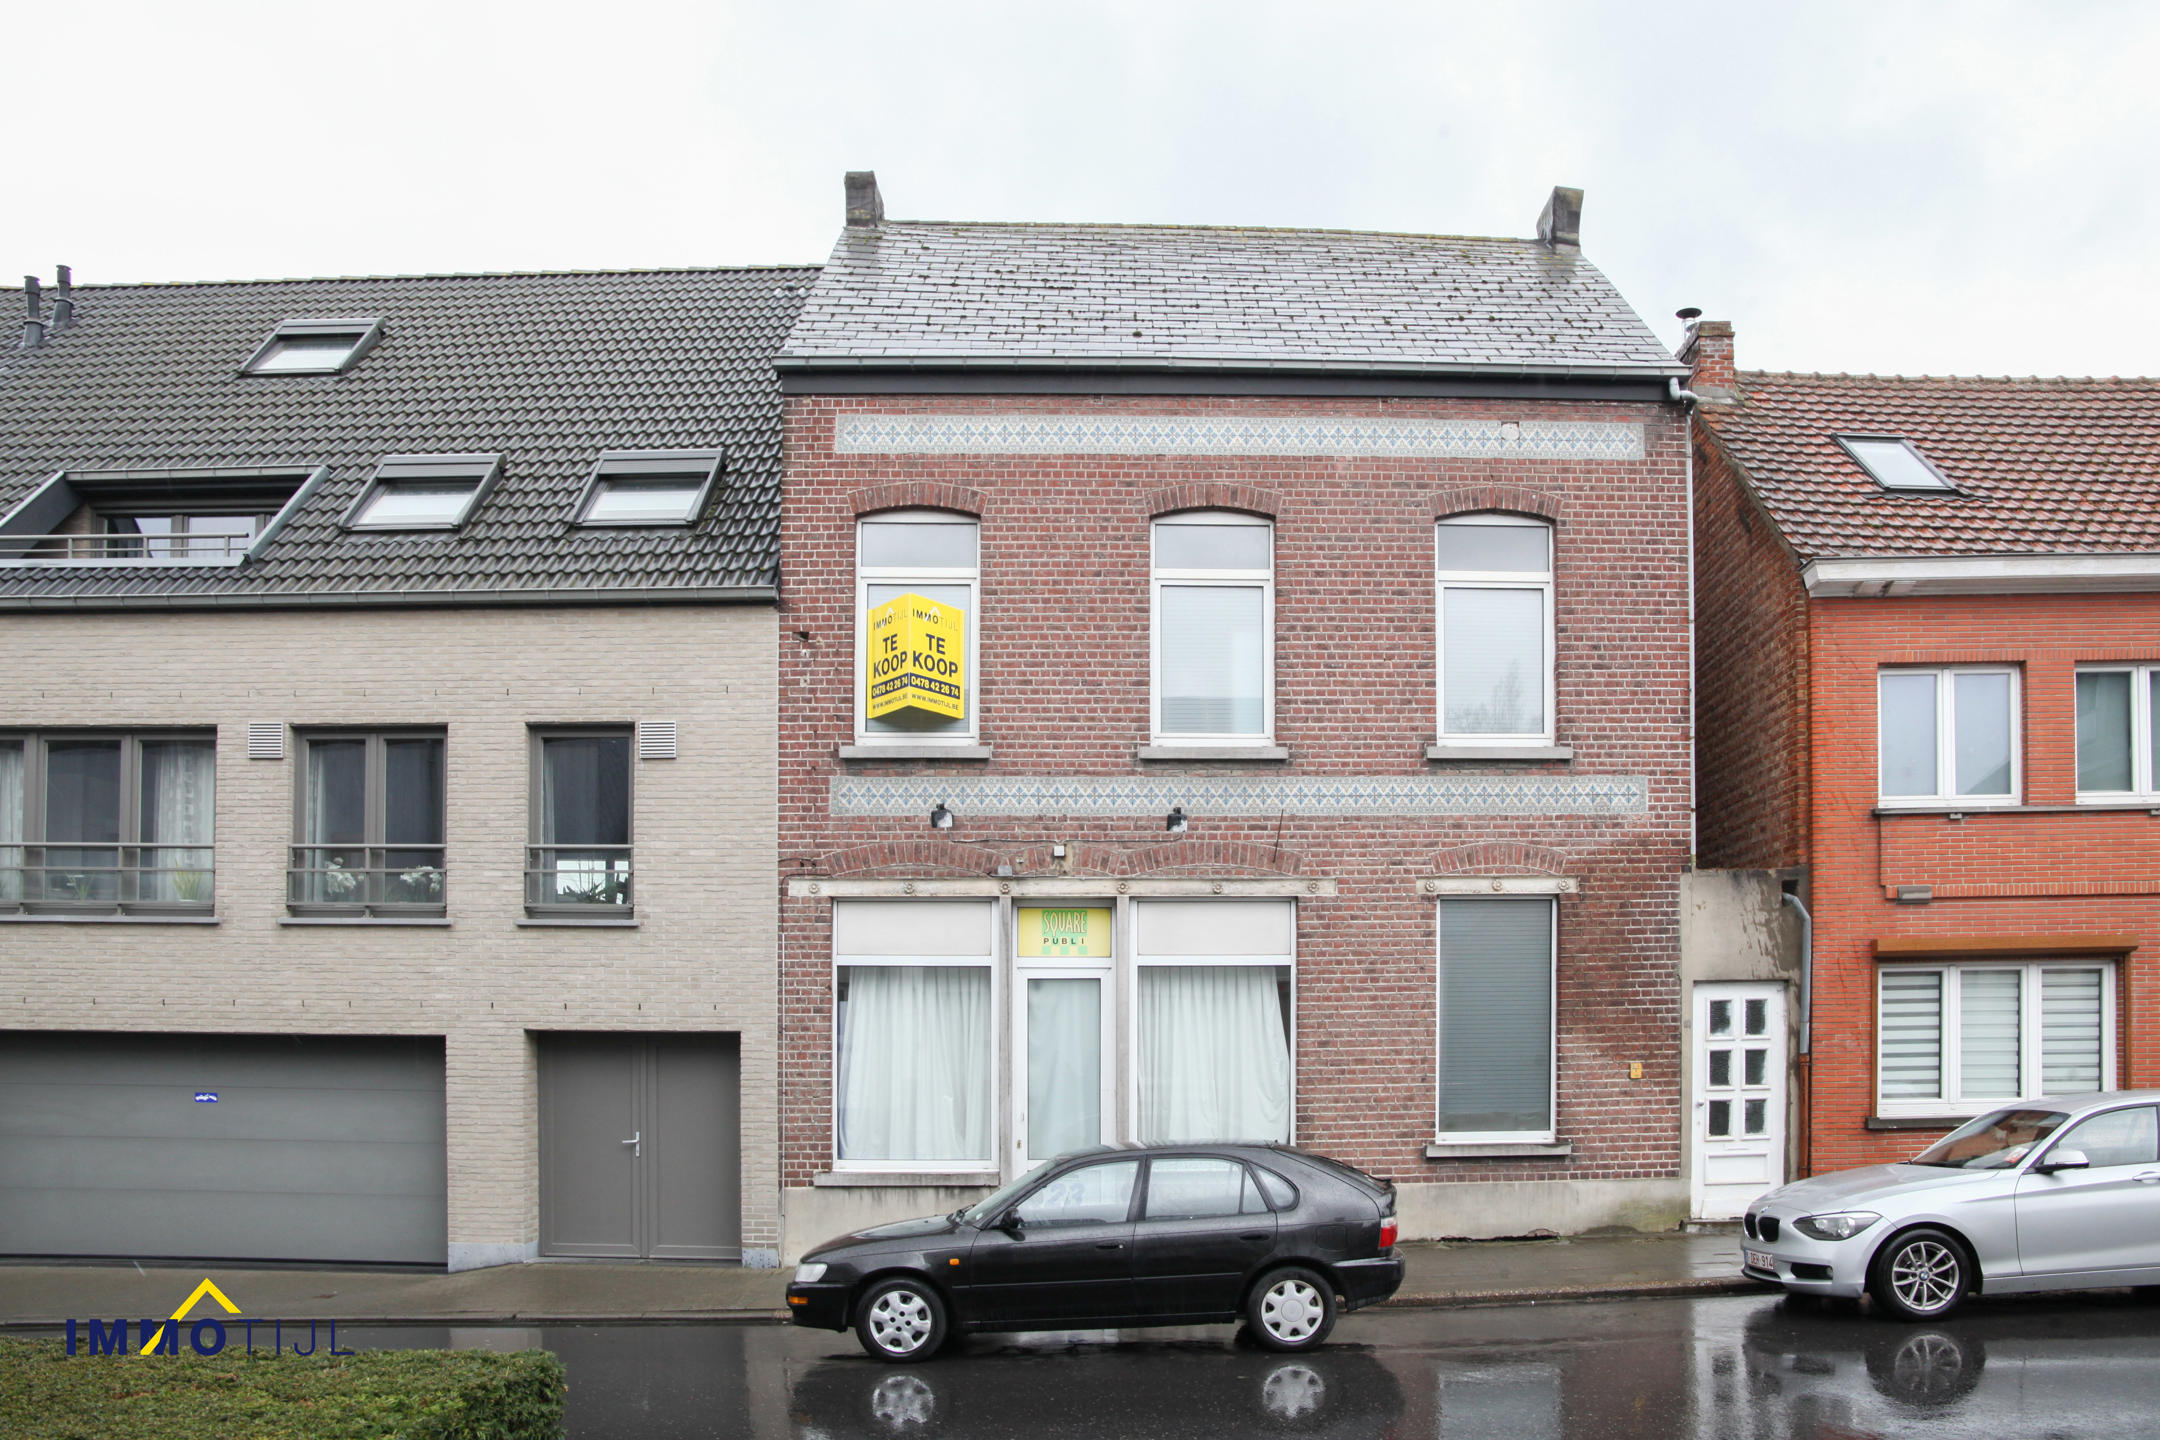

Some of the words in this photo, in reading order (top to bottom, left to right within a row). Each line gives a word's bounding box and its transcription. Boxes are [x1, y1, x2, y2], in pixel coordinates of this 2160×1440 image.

[883, 633, 898, 654] TE
[925, 633, 945, 655] TE
[873, 651, 908, 679] KOOP
[912, 650, 958, 677] KOOP
[911, 675, 930, 689] 0478
[930, 681, 940, 692] 42
[941, 684, 950, 695] 26
[950, 686, 959, 697] 74
[1043, 911, 1087, 937] SQUARE
